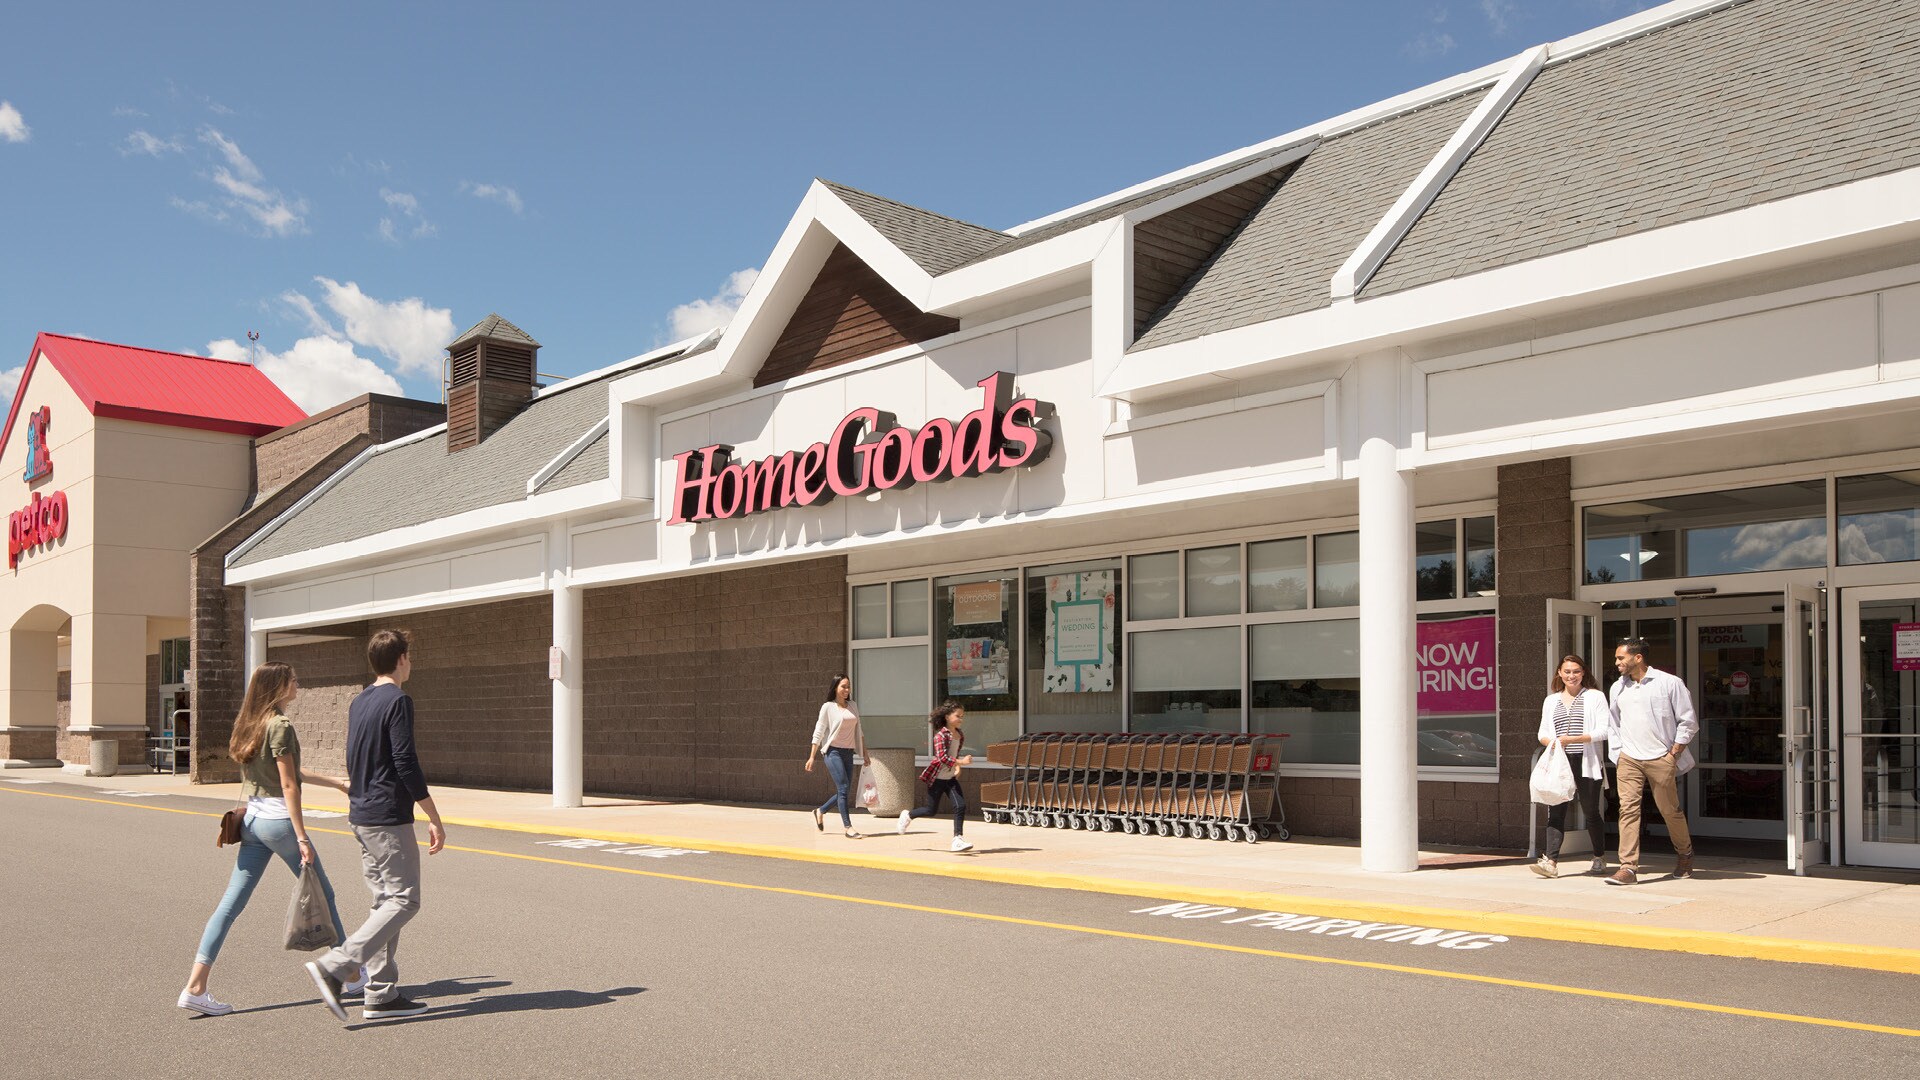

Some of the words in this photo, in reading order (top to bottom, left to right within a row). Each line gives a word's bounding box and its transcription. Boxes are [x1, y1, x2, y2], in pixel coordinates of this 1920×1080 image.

[666, 370, 1050, 526] HomeGoods
[9, 491, 67, 569] petco
[958, 593, 997, 604] OUTDOORS
[1061, 622, 1096, 632] WEDDING
[1701, 634, 1748, 645] FLORAL
[1416, 641, 1479, 667] NOW
[1416, 667, 1494, 692] IRING!
[1129, 902, 1238, 919] NO
[1221, 912, 1509, 950] PARKING
